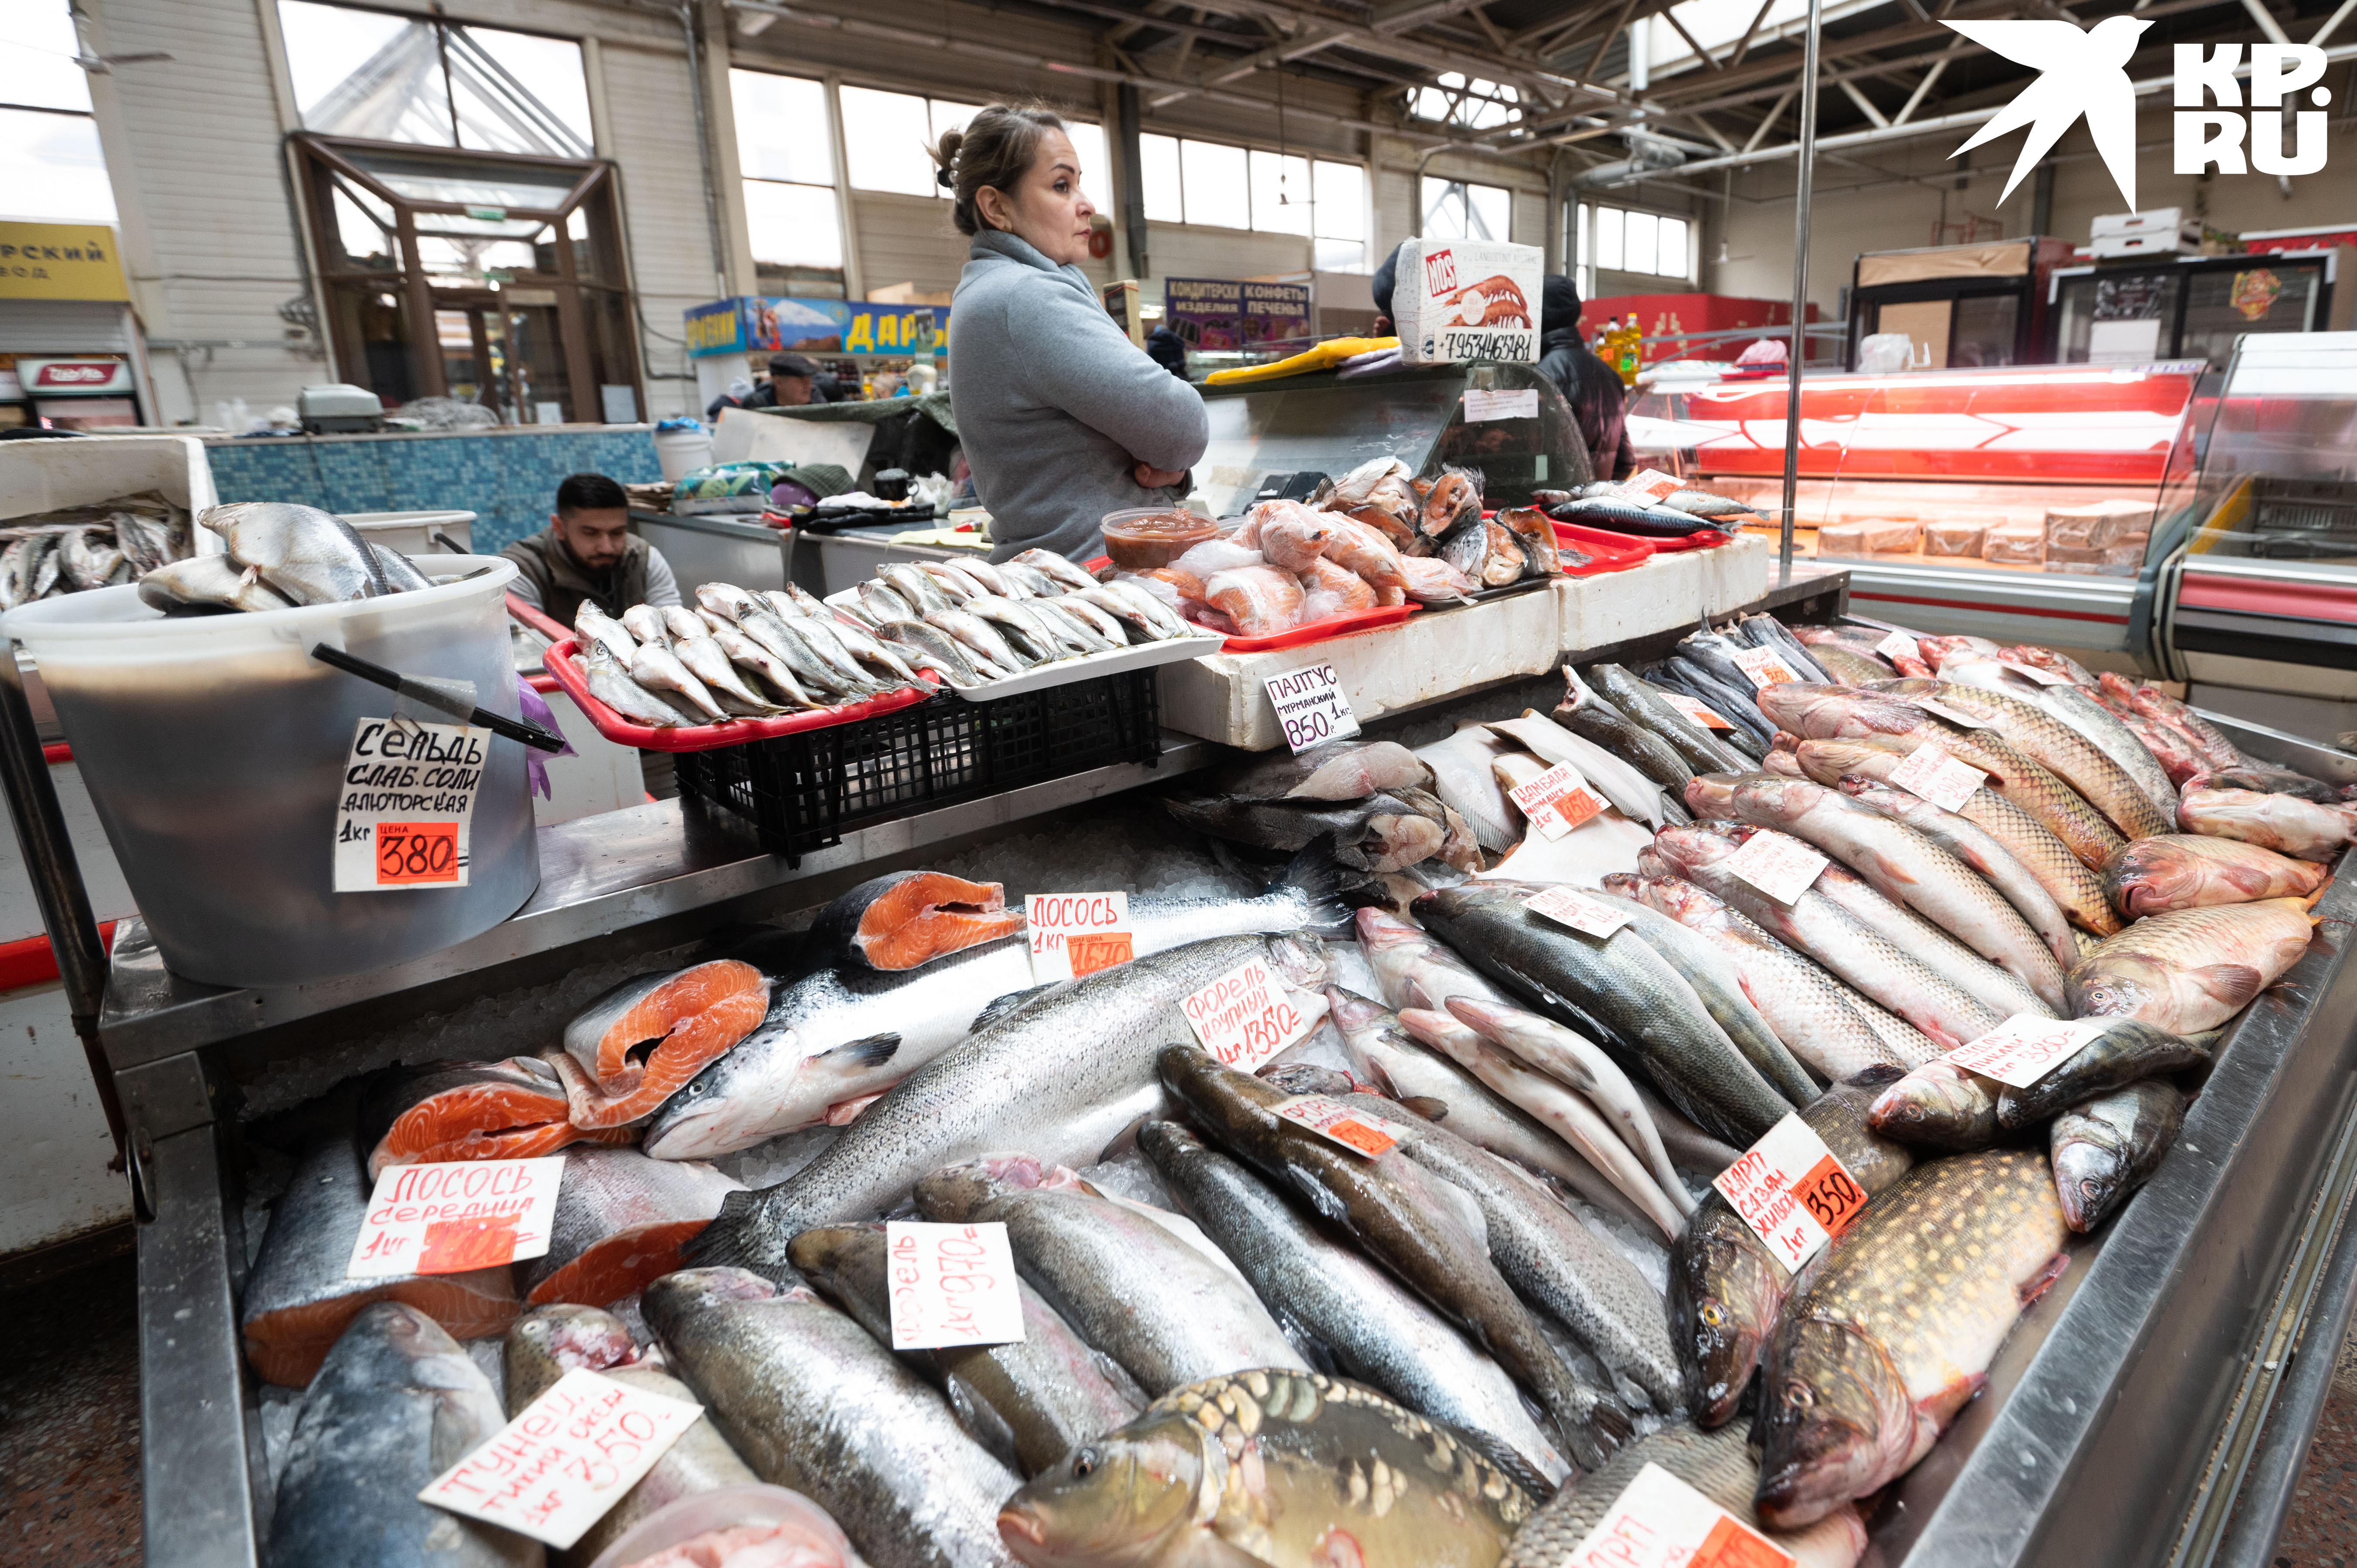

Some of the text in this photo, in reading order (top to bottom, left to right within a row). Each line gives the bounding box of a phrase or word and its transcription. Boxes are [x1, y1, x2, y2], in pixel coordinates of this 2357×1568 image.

[1176, 301, 1238, 313] ИЗДЕЛИЯ
[1244, 285, 1307, 301] КОНФЕТЫ
[1267, 664, 1337, 700] ПАЛТУС
[1277, 687, 1336, 714] МУРМАНСКИЙ
[1286, 711, 1328, 746] 850
[1514, 767, 1572, 805] КАМБАЛА
[341, 791, 467, 813] АЛЮТОРСКАЯ
[380, 826, 409, 834] ЦЕНА
[1029, 897, 1117, 927] ЛОСОСЬ
[1949, 1034, 2006, 1063] СУДАК
[385, 1165, 533, 1203] ЛОСОСЬ
[1719, 1151, 1768, 1201] КАРП
[1794, 1179, 1811, 1197] ЦЕНА
[1739, 1168, 1791, 1219] САЗАН
[439, 1392, 585, 1494] ТУНЕЦ
